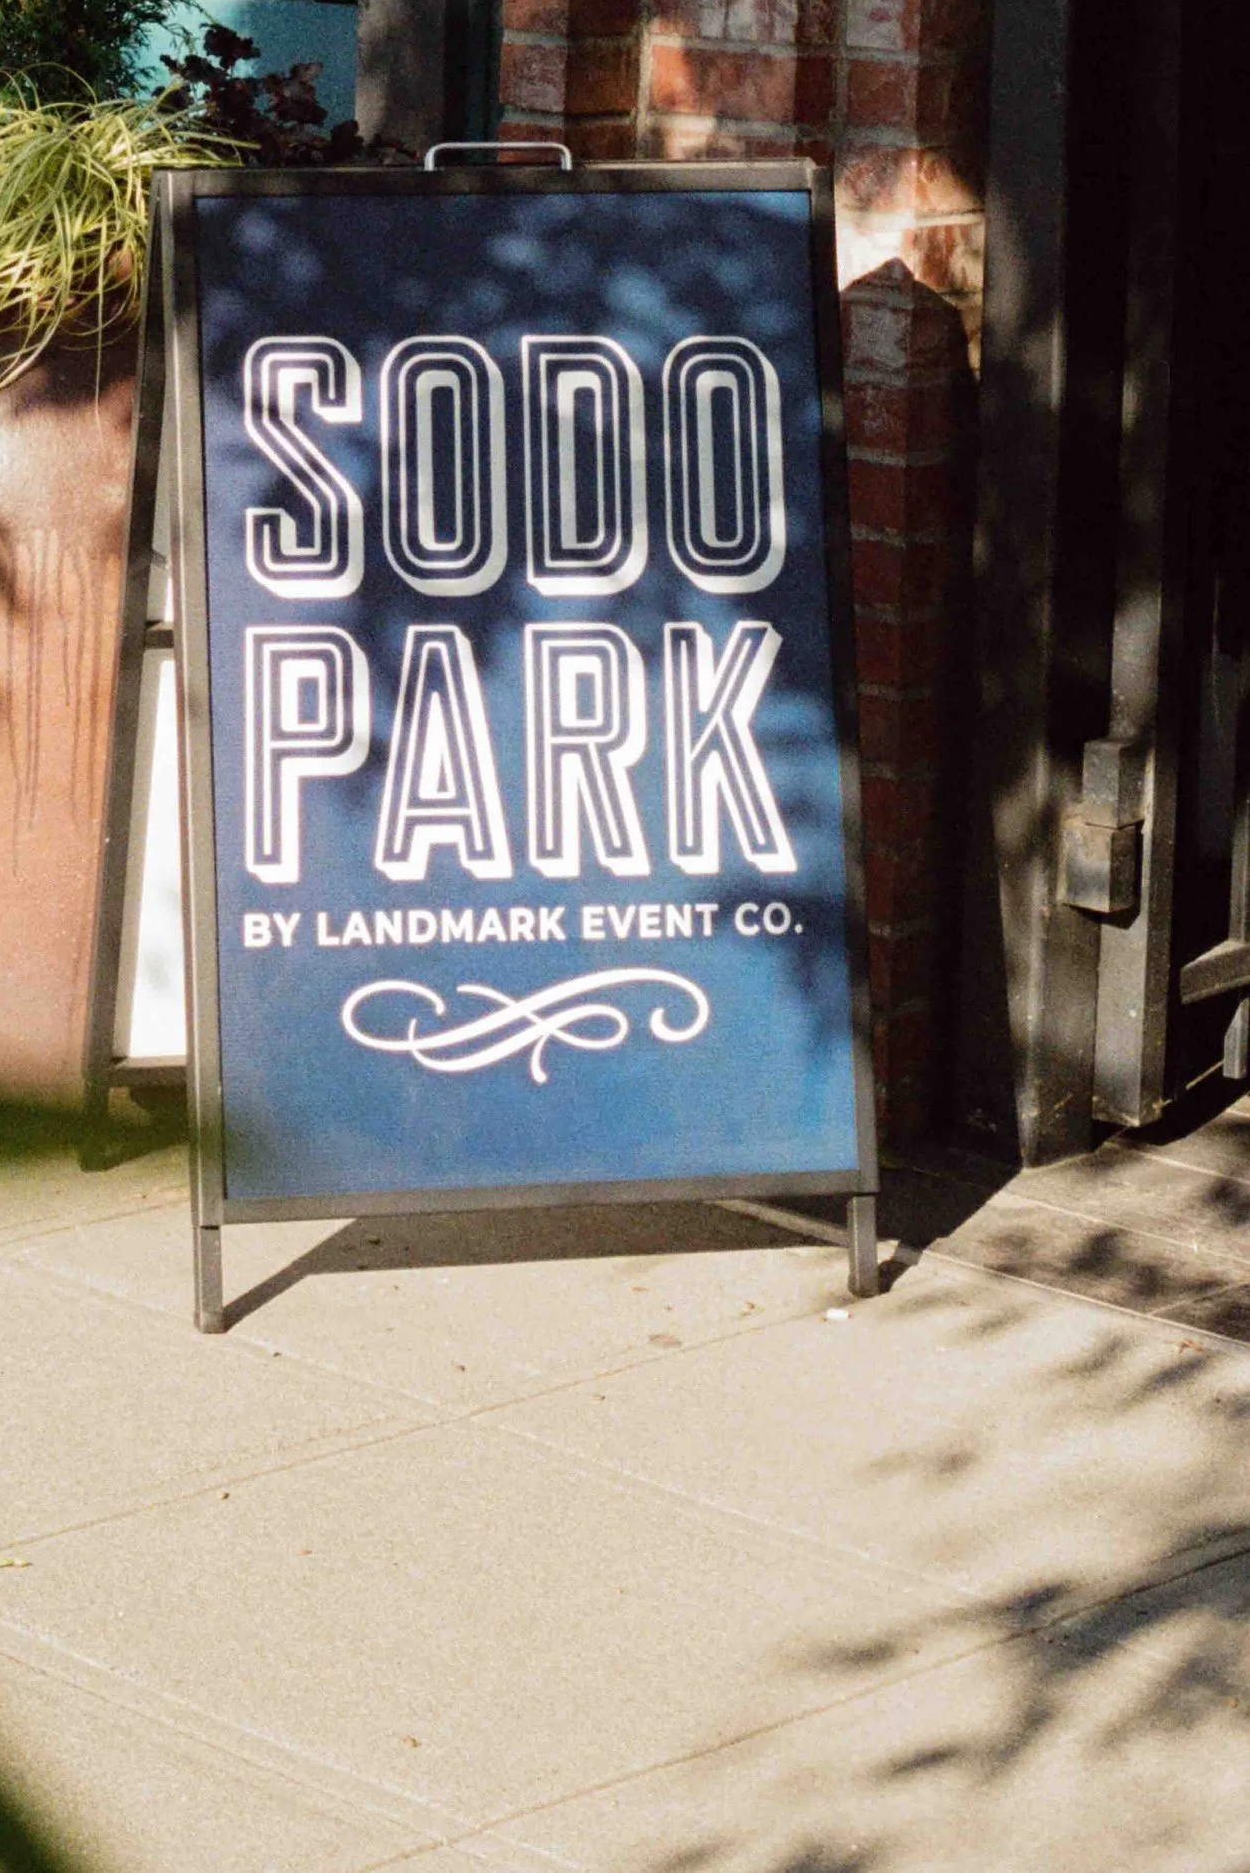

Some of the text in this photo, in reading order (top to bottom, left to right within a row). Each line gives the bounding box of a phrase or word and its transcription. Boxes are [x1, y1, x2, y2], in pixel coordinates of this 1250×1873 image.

[245, 335, 786, 597] SODO
[245, 622, 796, 884] PARK
[243, 901, 803, 948] BY LANDMARK EVENT CO.
